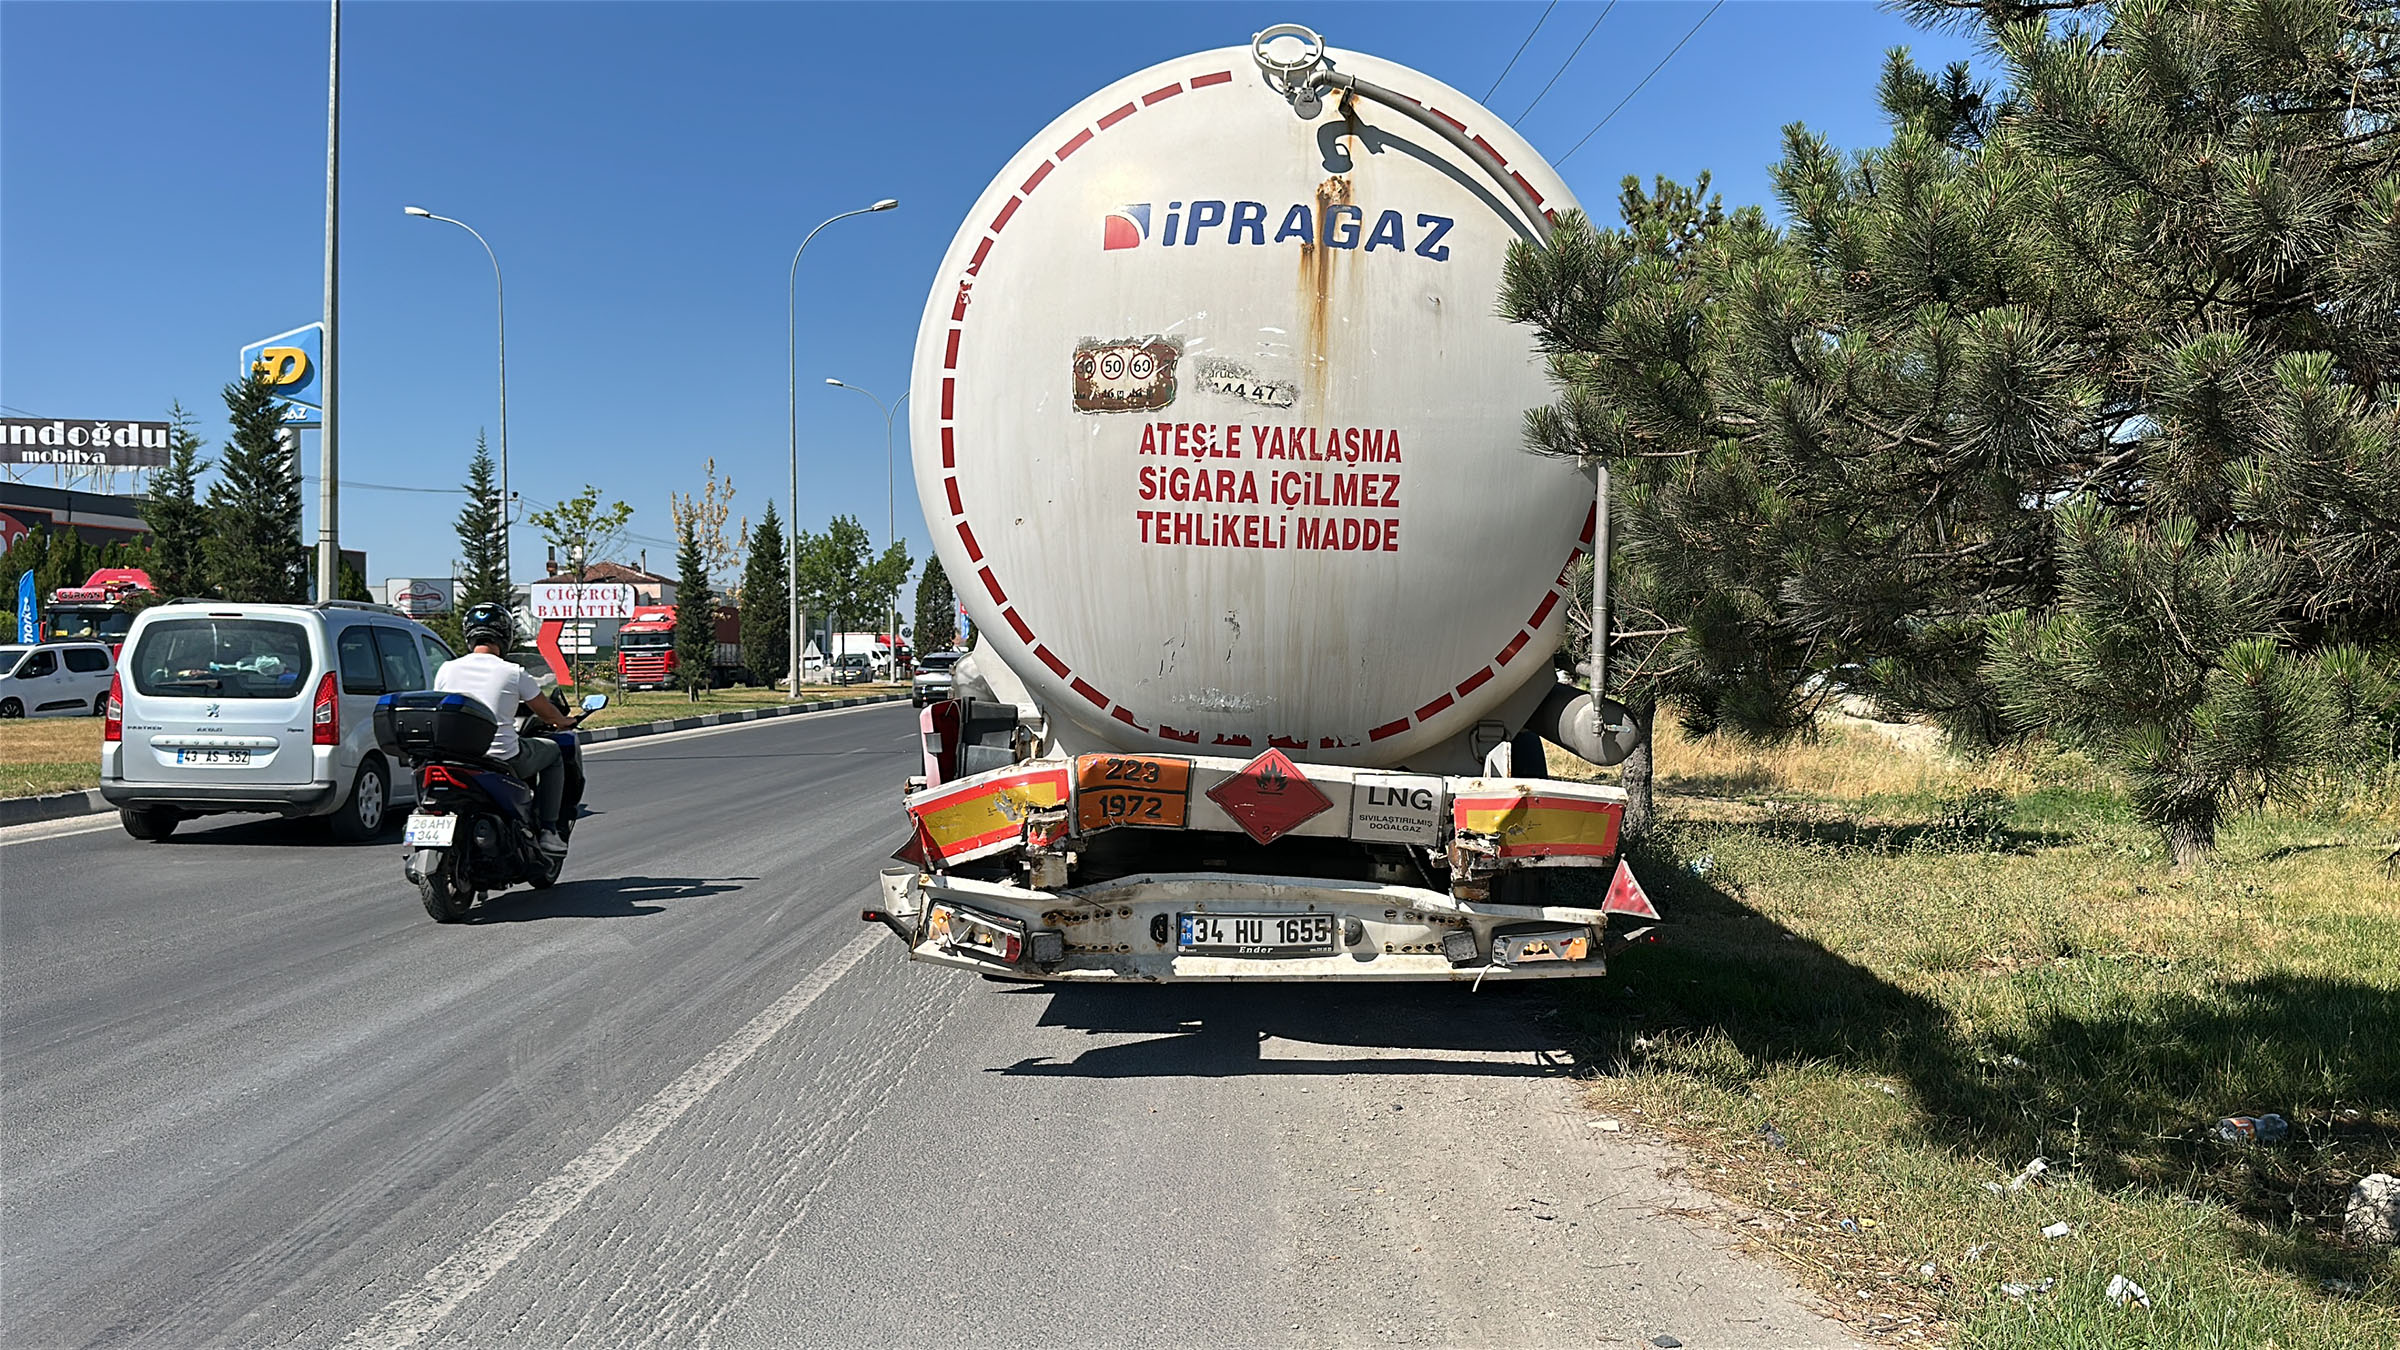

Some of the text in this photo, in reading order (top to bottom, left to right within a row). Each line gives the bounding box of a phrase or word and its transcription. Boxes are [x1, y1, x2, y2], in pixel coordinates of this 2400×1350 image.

[1105, 360, 1122, 373] 50
[1133, 359, 1151, 373] 60
[1252, 385, 1276, 400] 47
[0, 420, 167, 448] ndoğdu
[1139, 422, 1401, 468] ATEŞLE YAKLAŞMA
[22, 449, 107, 464] mobilya
[1296, 516, 1400, 552] MADDE
[537, 602, 628, 617] BAHATTİN
[184, 751, 248, 764] 43 AS 552
[1105, 758, 1160, 783] 223
[1368, 785, 1433, 811] LNG
[1099, 794, 1163, 819] 1972
[413, 819, 454, 830] 26 AHY
[1262, 825, 1271, 836] 2
[417, 830, 440, 841] 344
[1194, 919, 1328, 944] 34 HU 1655
[1238, 946, 1274, 954] Ender
